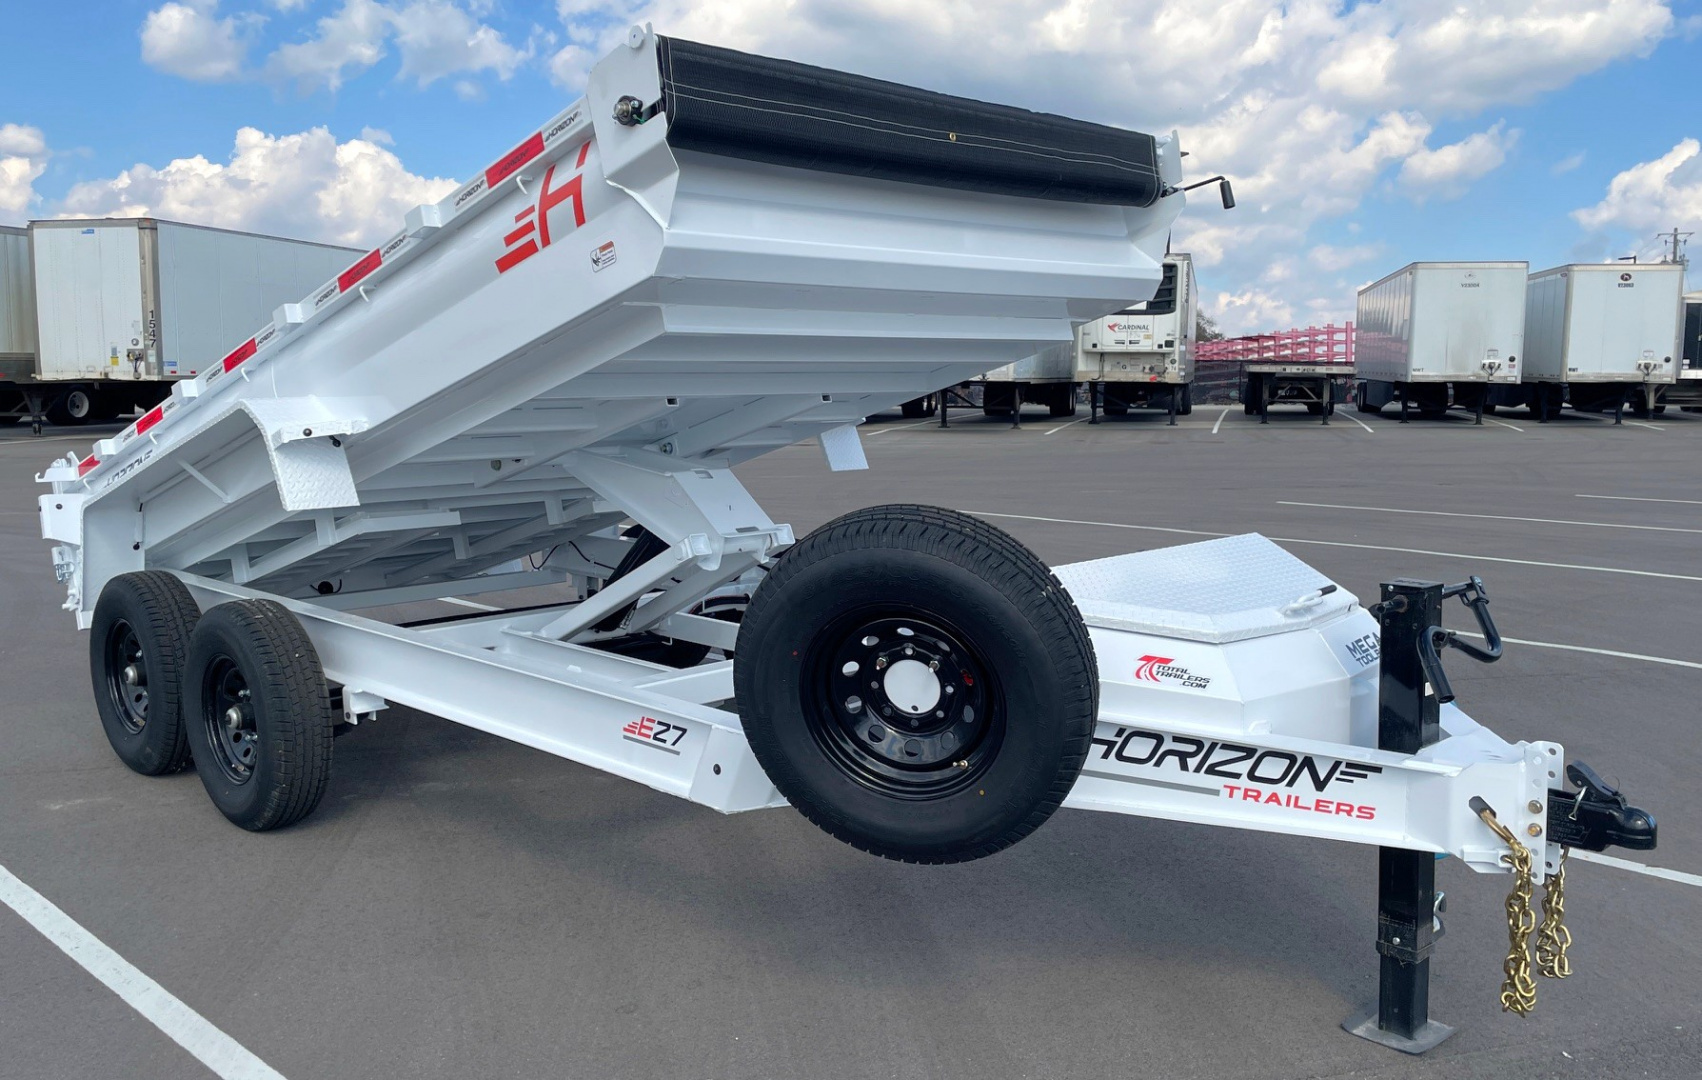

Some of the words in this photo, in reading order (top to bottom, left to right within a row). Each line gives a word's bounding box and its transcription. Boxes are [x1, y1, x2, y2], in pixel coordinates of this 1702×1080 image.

[148, 309, 157, 348] 1547
[1155, 664, 1191, 675] TOTAL
[1155, 670, 1211, 684] TRAILERS
[1223, 784, 1376, 820] TRAILERS
